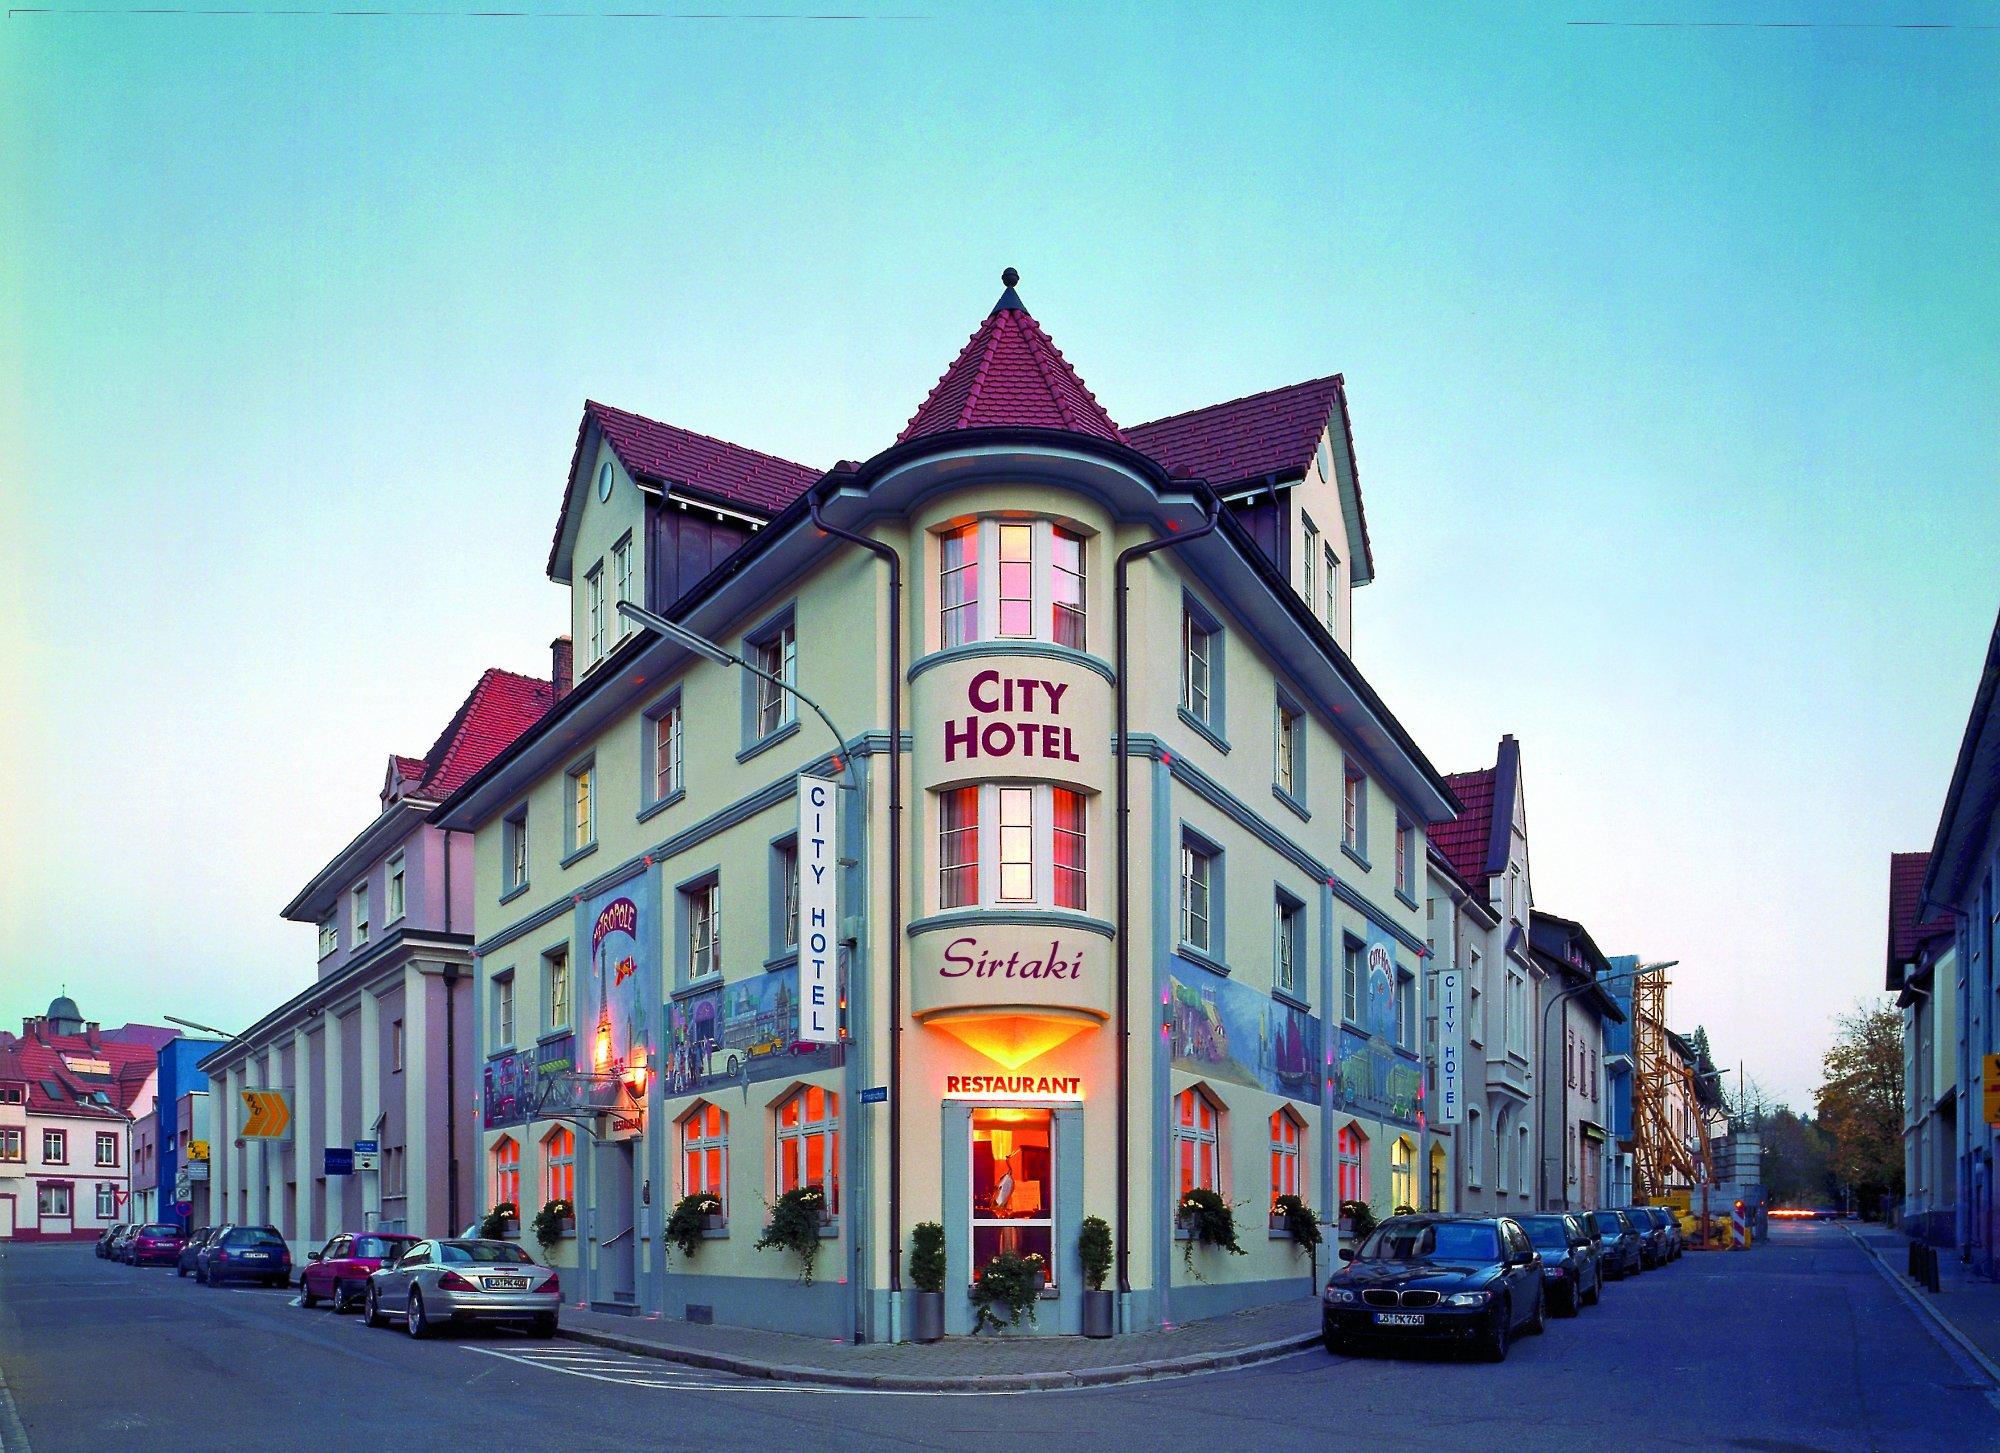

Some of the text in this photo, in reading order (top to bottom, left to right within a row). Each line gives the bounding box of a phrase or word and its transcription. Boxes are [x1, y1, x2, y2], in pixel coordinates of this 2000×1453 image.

[968, 670, 1068, 714] CITY
[945, 716, 1080, 762] HOTEL
[810, 787, 826, 1031] CITY HOTEL
[939, 938, 1083, 979] Sirtaki
[1445, 976, 1456, 1119] CITY HOTEL
[947, 1075, 1080, 1094] RESTAURANT
